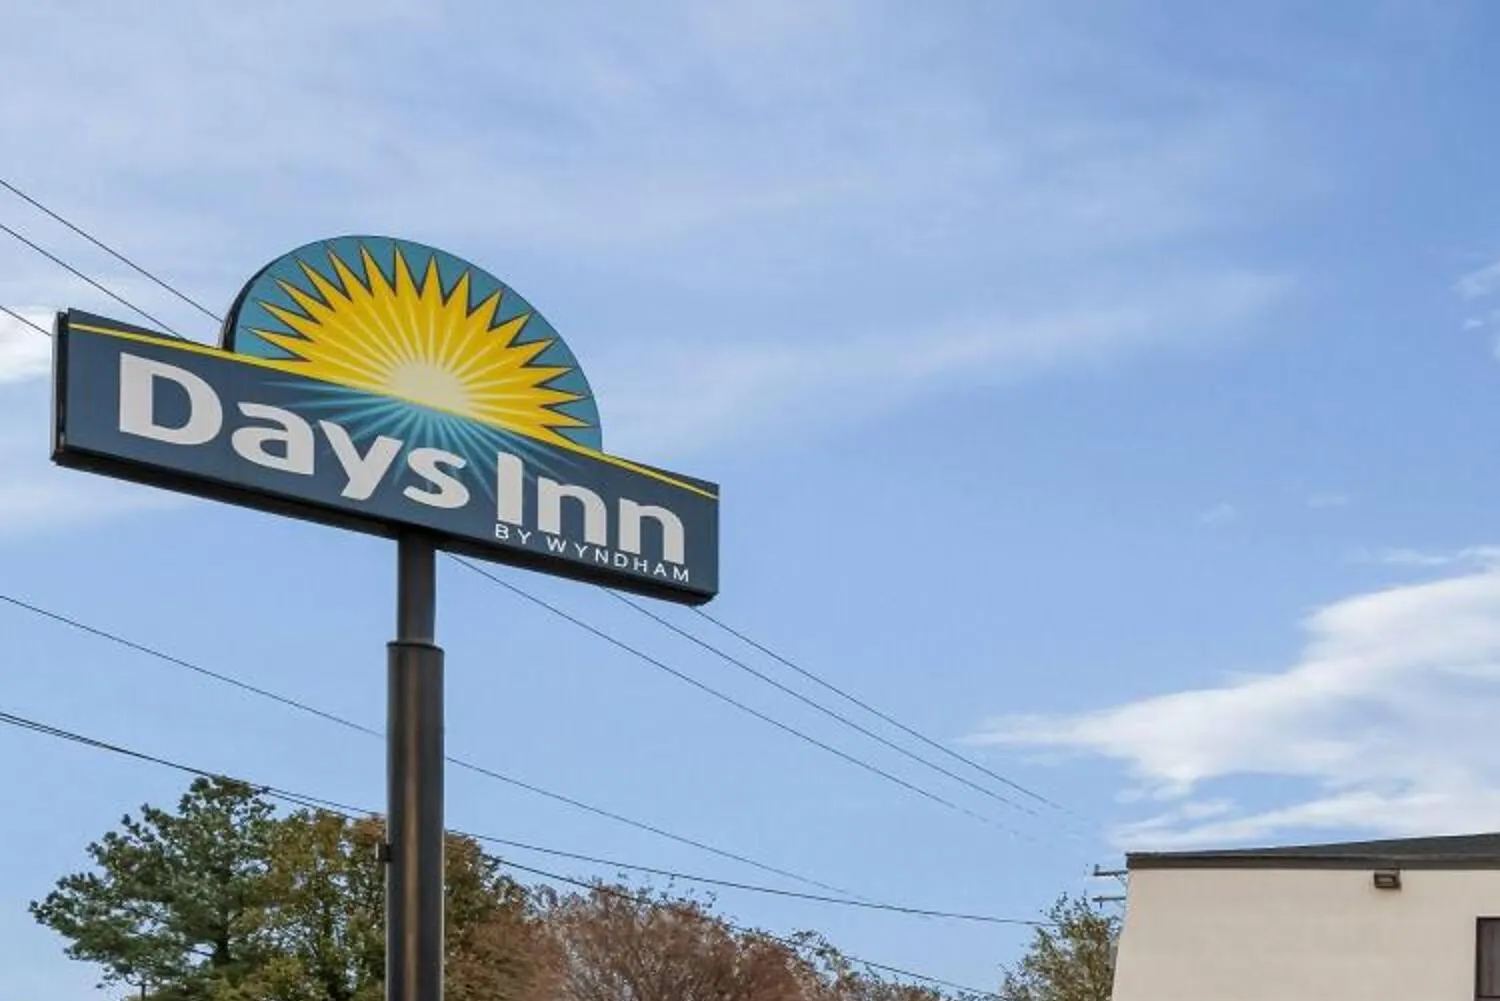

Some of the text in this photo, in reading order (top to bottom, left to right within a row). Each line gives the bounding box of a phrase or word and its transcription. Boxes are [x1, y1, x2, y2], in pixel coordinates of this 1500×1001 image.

[119, 352, 685, 565] Days Inn
[495, 523, 689, 583] BY WYNDHAM
